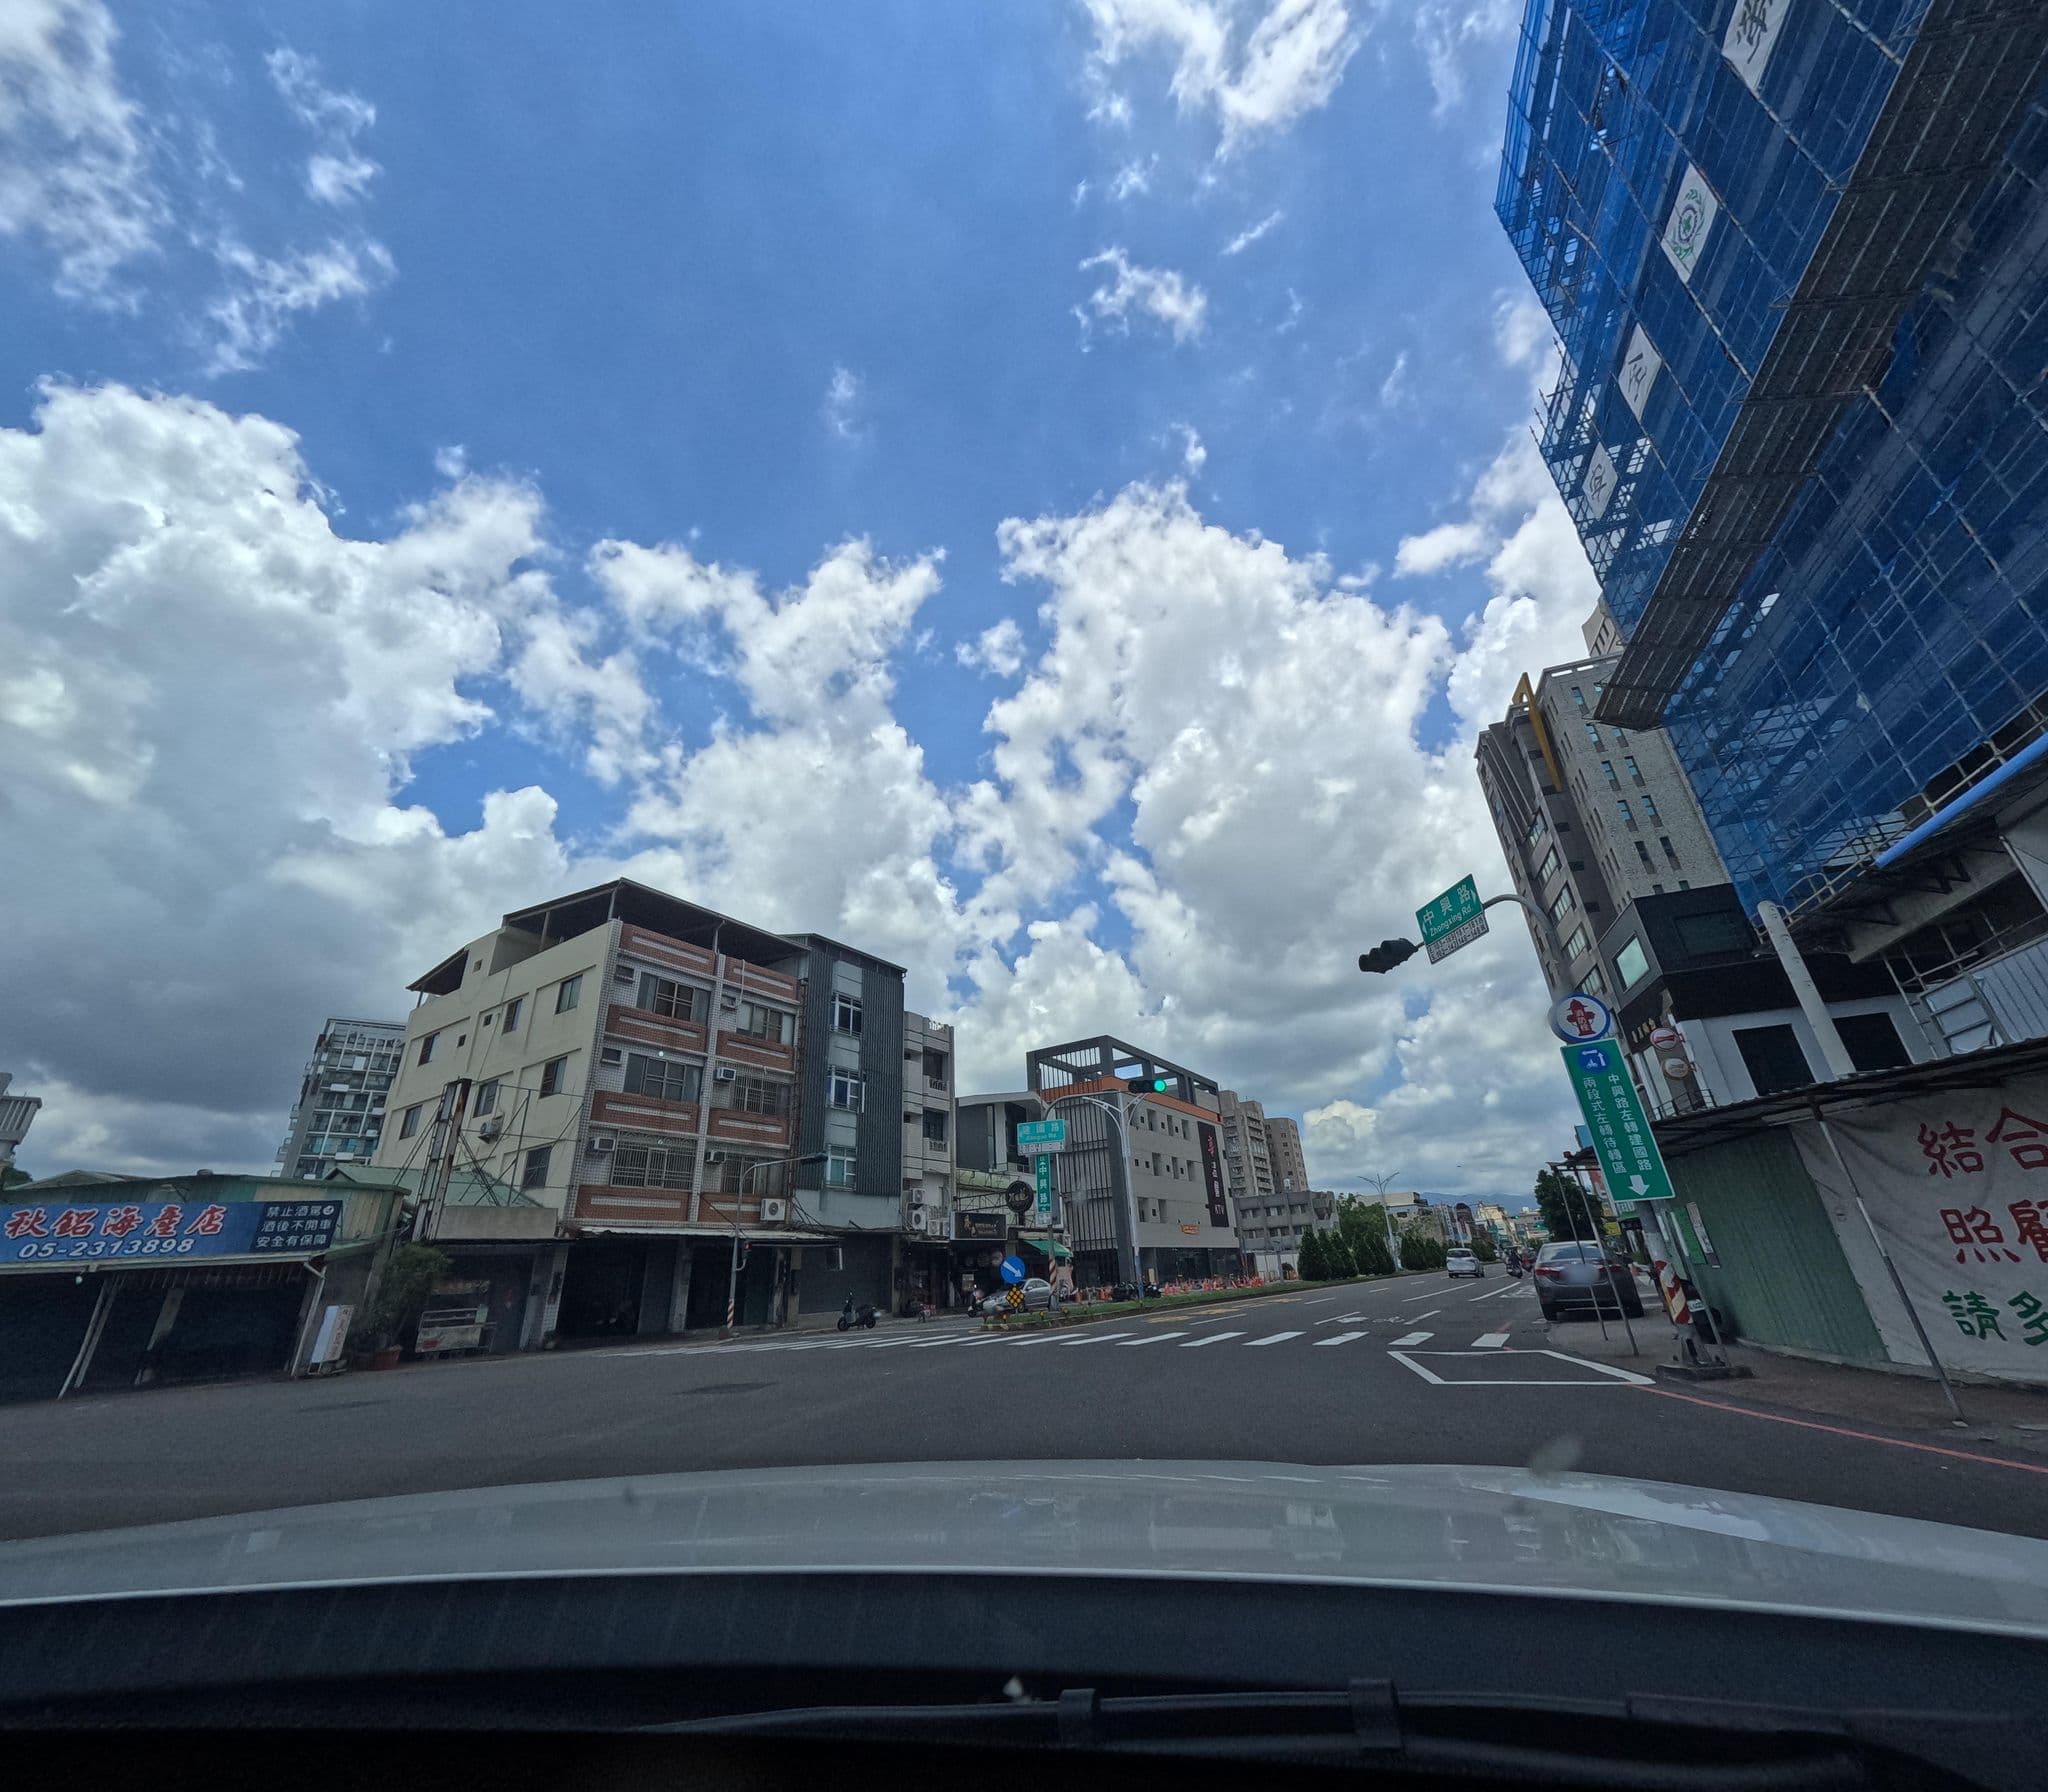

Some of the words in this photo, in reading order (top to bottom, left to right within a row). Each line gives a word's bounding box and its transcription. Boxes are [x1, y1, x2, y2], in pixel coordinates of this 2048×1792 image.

[1422, 884, 1471, 925] 中興路
[1430, 912, 1463, 937] Zhongxing
[1583, 1077, 1627, 1173] 兩段式左轉待轉區
[1608, 1074, 1652, 1171] 中興路左轉建國路
[267, 1205, 322, 1217] 禁止酒駕
[260, 1219, 333, 1232] 酒後不開車
[19, 1239, 195, 1258] 05-2313898
[256, 1234, 327, 1247] 安全有保障
